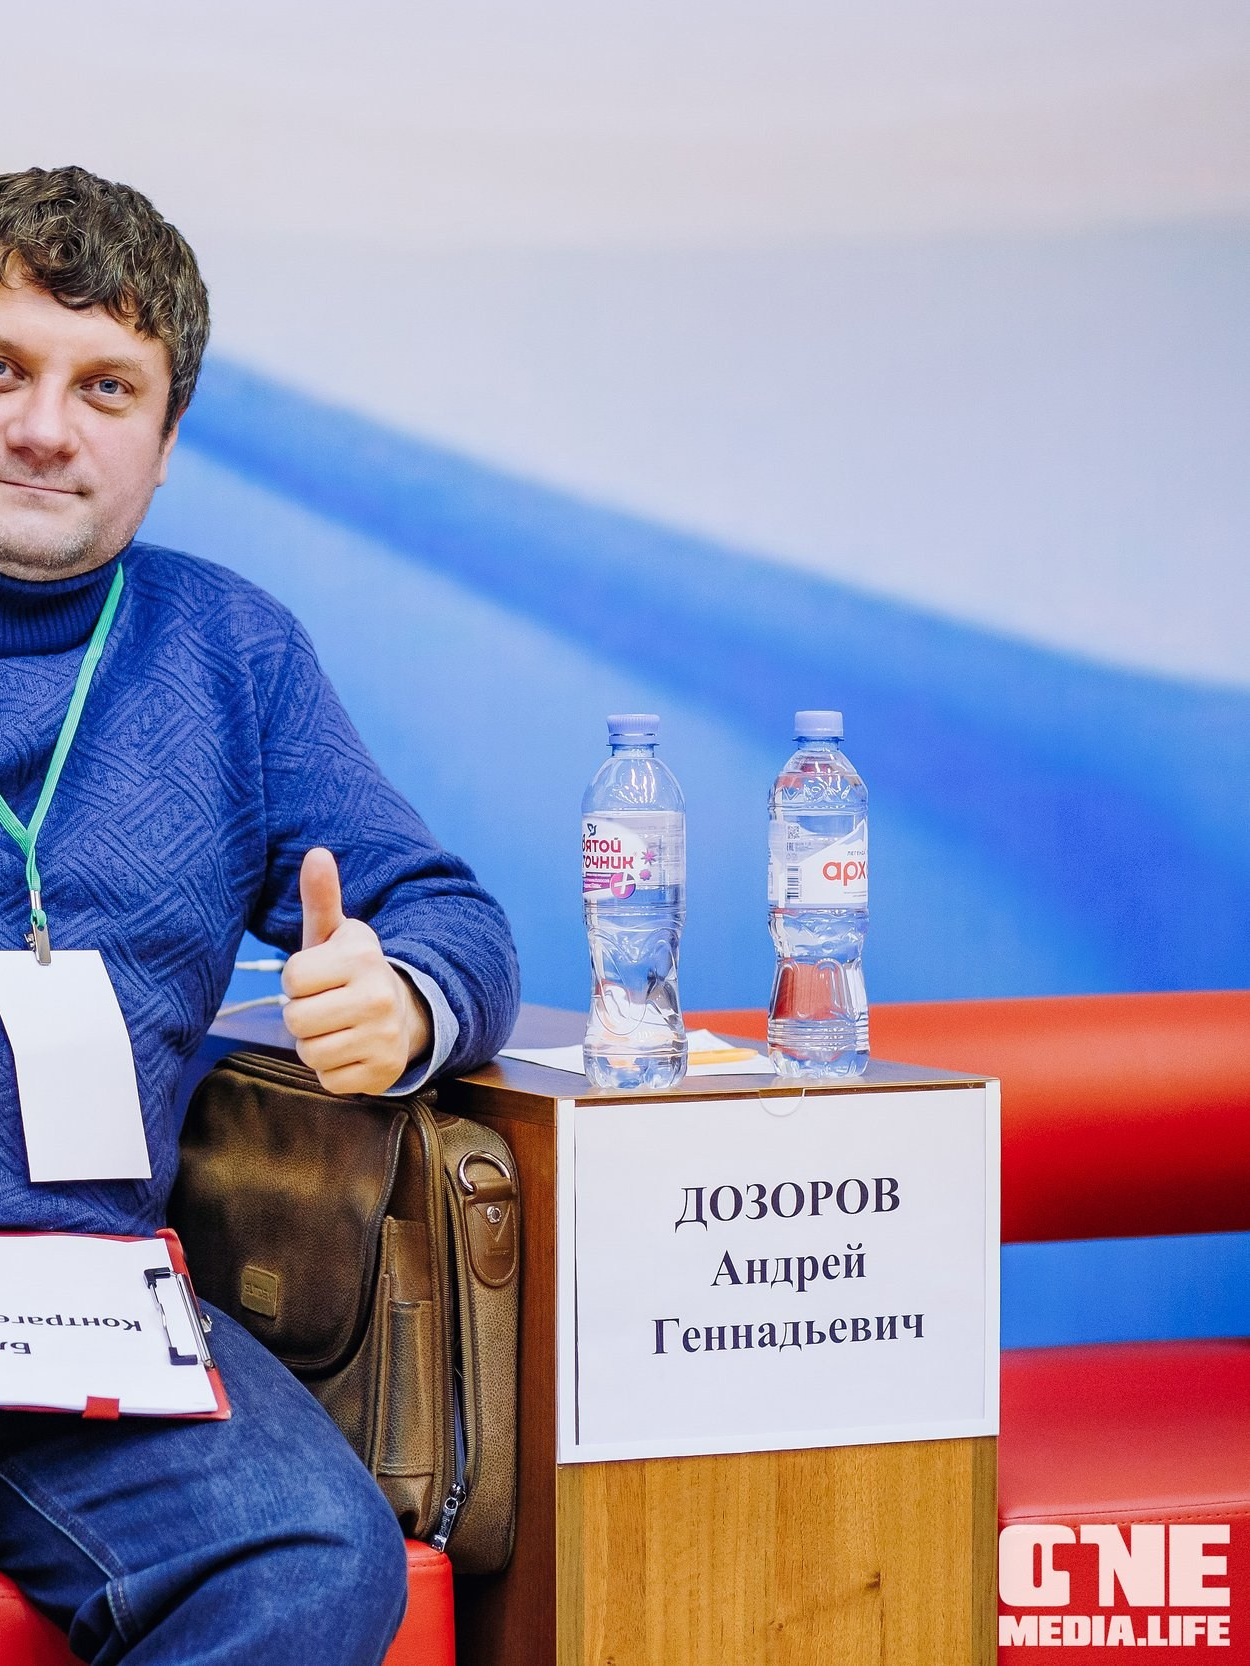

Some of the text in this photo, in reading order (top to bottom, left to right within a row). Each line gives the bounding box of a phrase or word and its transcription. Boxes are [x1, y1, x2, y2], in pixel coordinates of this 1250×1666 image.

[674, 1177, 901, 1233] ДОЗОРОВ
[710, 1242, 867, 1293] Андрей
[651, 1313, 926, 1355] Геннадьевич
